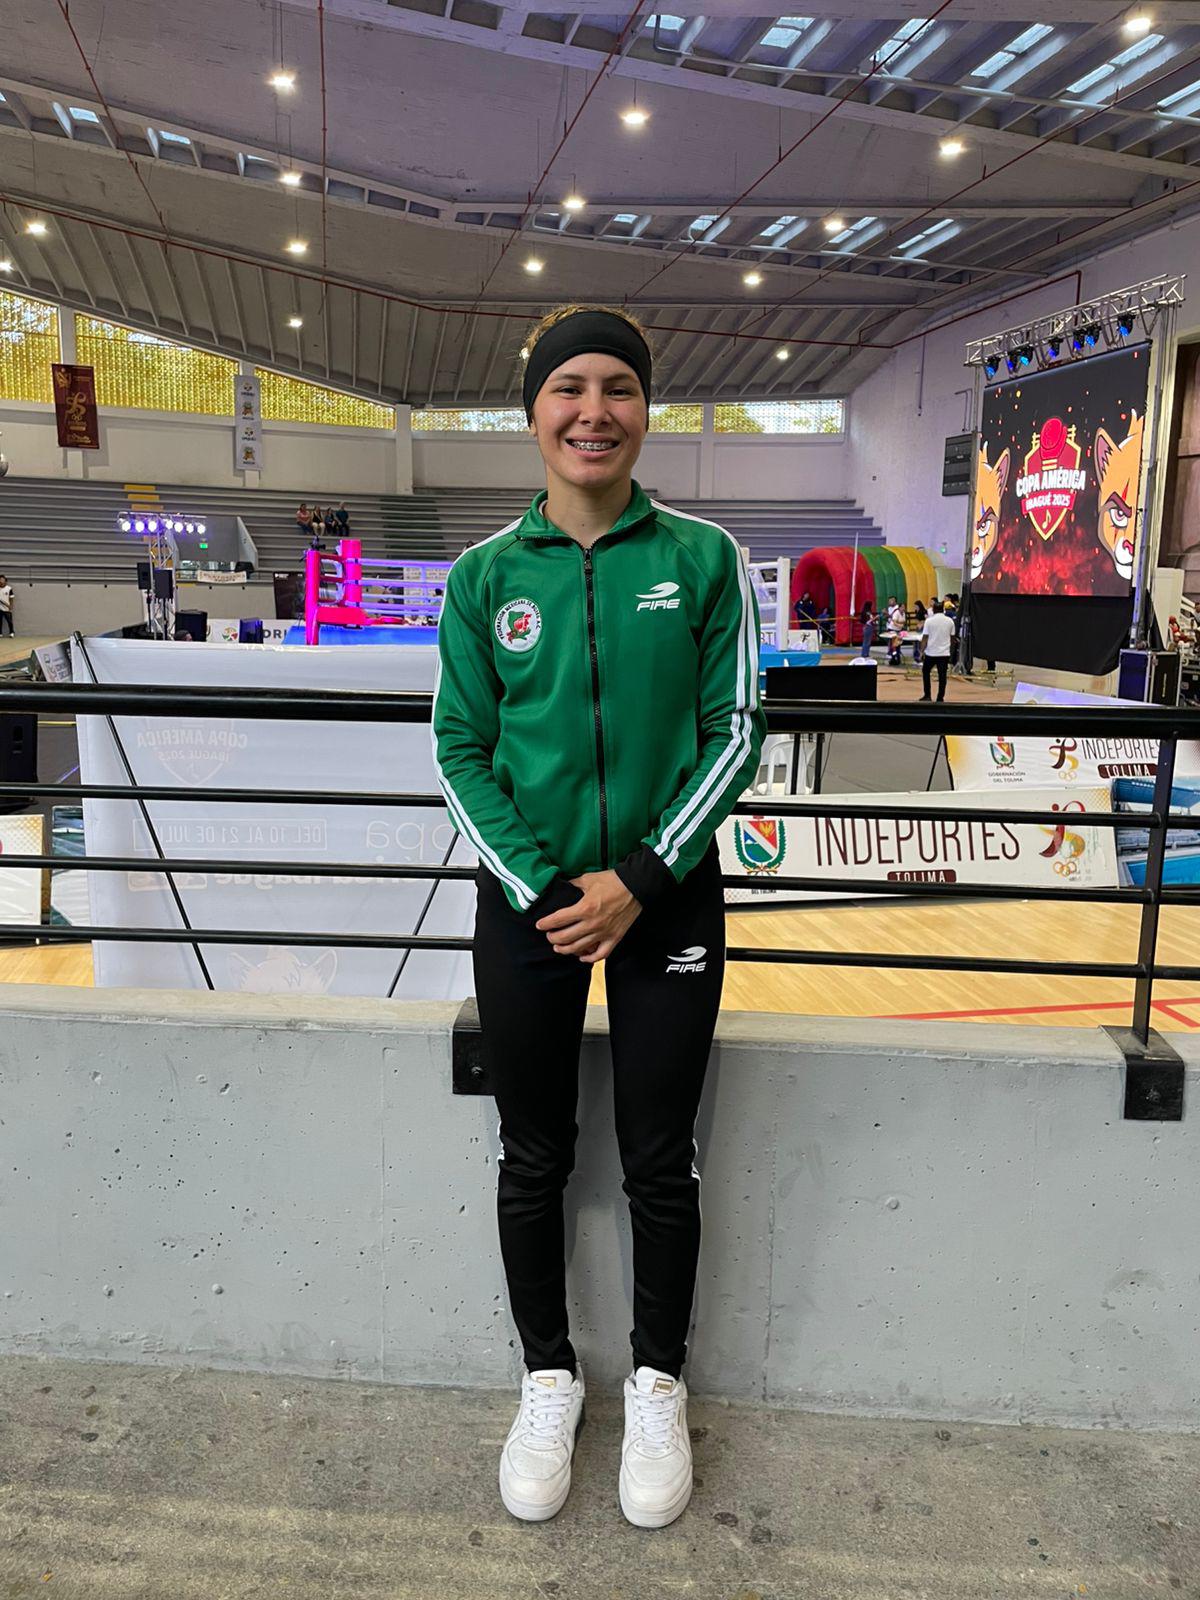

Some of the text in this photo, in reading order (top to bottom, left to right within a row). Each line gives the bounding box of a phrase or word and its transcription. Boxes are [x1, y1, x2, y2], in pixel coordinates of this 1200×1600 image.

[1016, 466, 1086, 498] COPA AMÉRICA
[1052, 493, 1071, 507] 2025
[636, 598, 681, 612] FIRE
[1104, 764, 1151, 777] TOLIMA
[665, 961, 707, 974] FIRE
